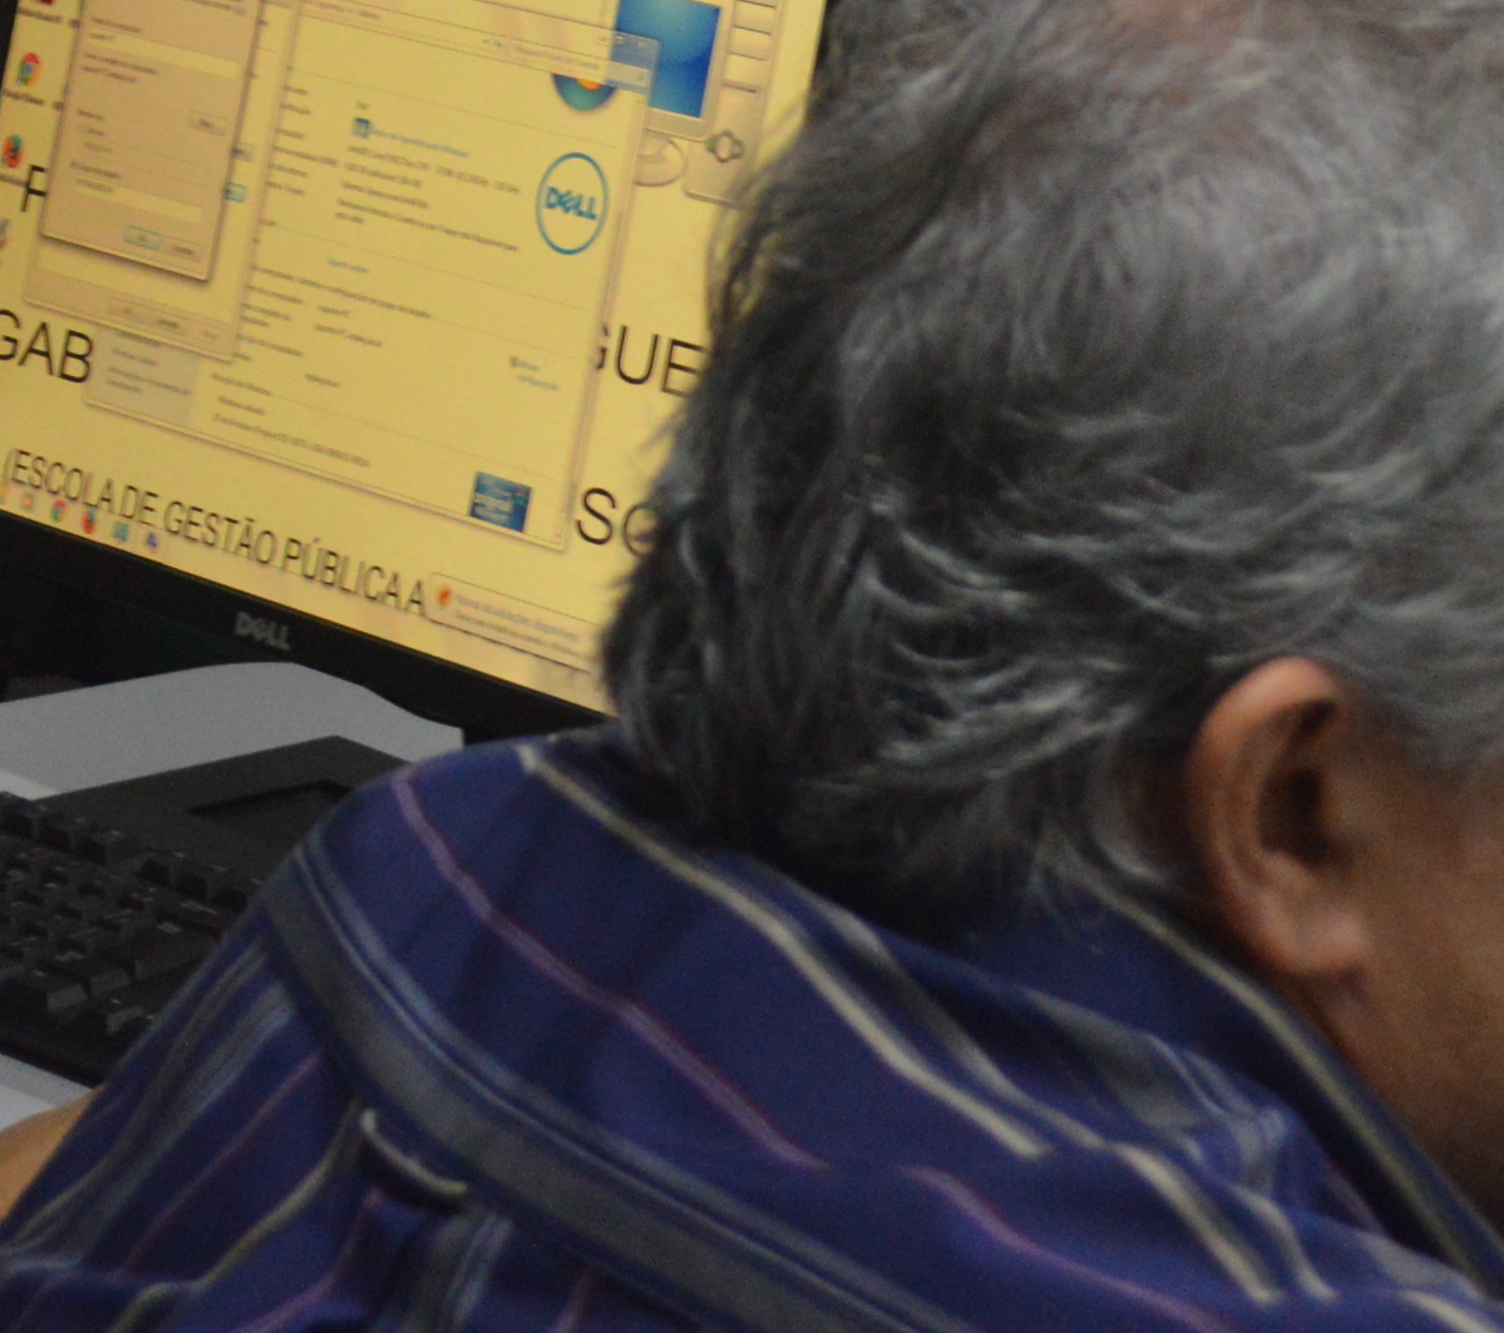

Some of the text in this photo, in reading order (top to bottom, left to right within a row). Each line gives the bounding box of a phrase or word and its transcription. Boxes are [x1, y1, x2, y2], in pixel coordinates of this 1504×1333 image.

[545, 185, 598, 222] DELL
[119, 484, 160, 527] DE
[163, 500, 277, 565] GESTÃO
[281, 536, 403, 609] PÚBLICA
